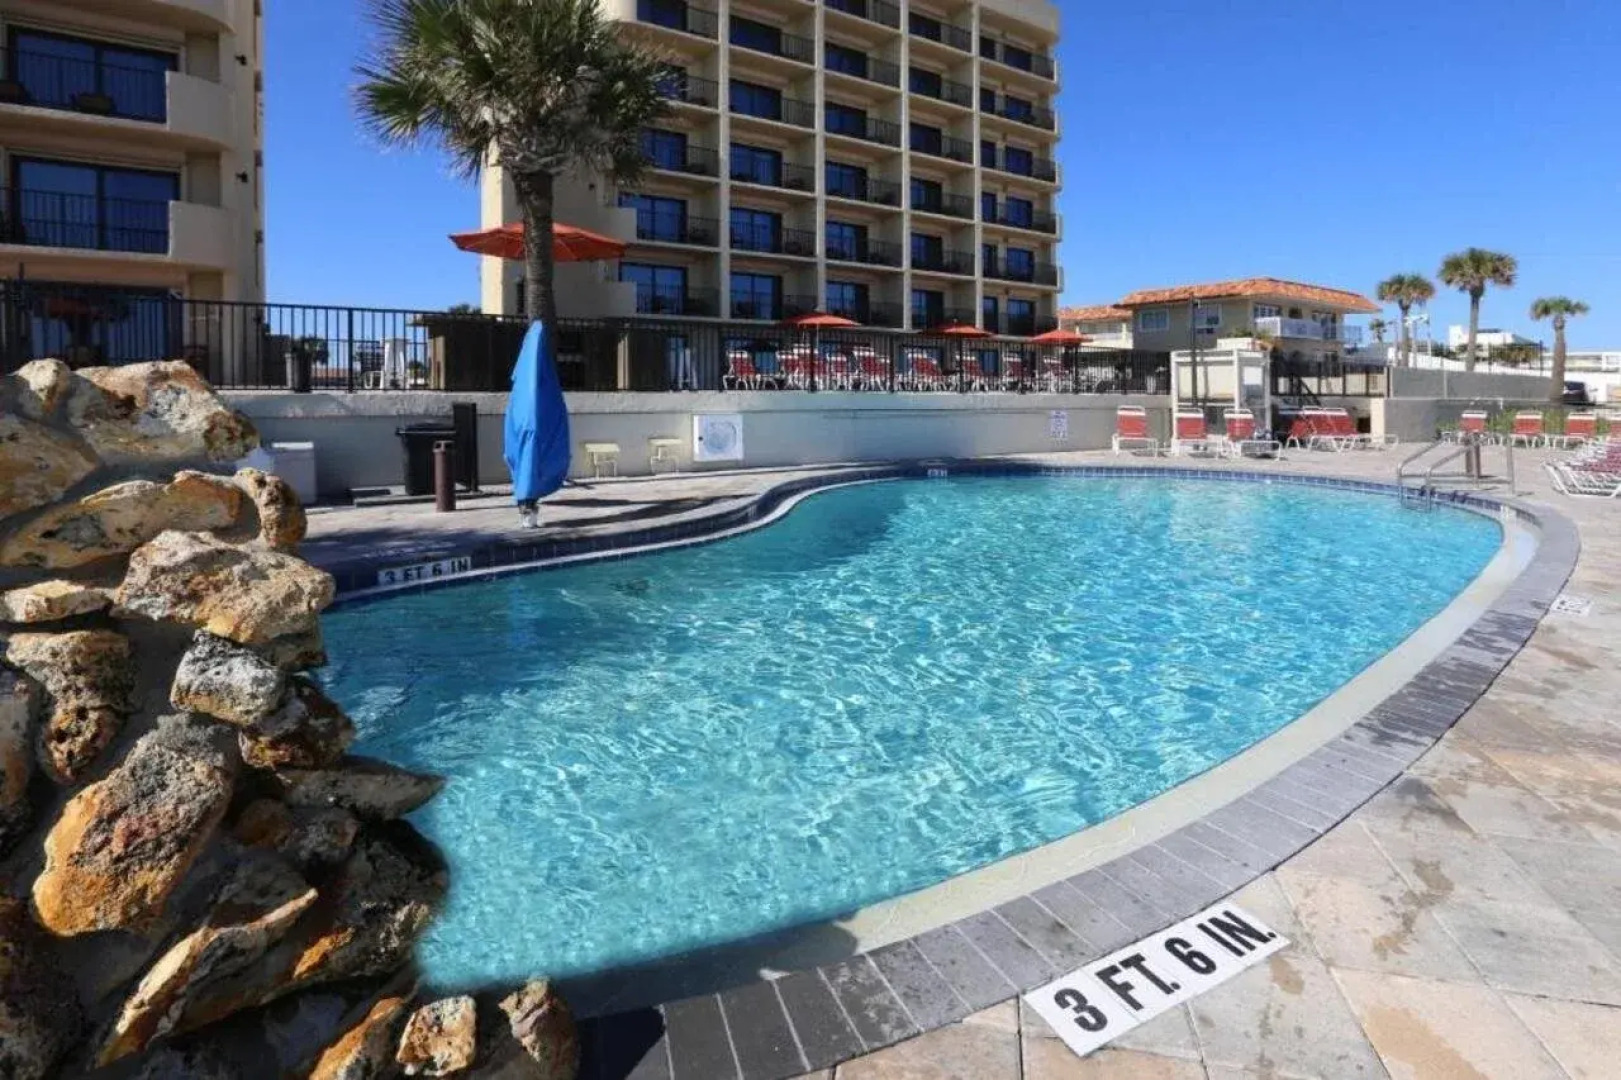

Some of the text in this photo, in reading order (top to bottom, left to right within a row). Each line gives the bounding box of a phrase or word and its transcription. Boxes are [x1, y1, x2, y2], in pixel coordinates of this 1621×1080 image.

[384, 570, 396, 583] 3
[432, 563, 442, 577] 6
[1053, 909, 1277, 1033] 3 FT. 6 IN.
